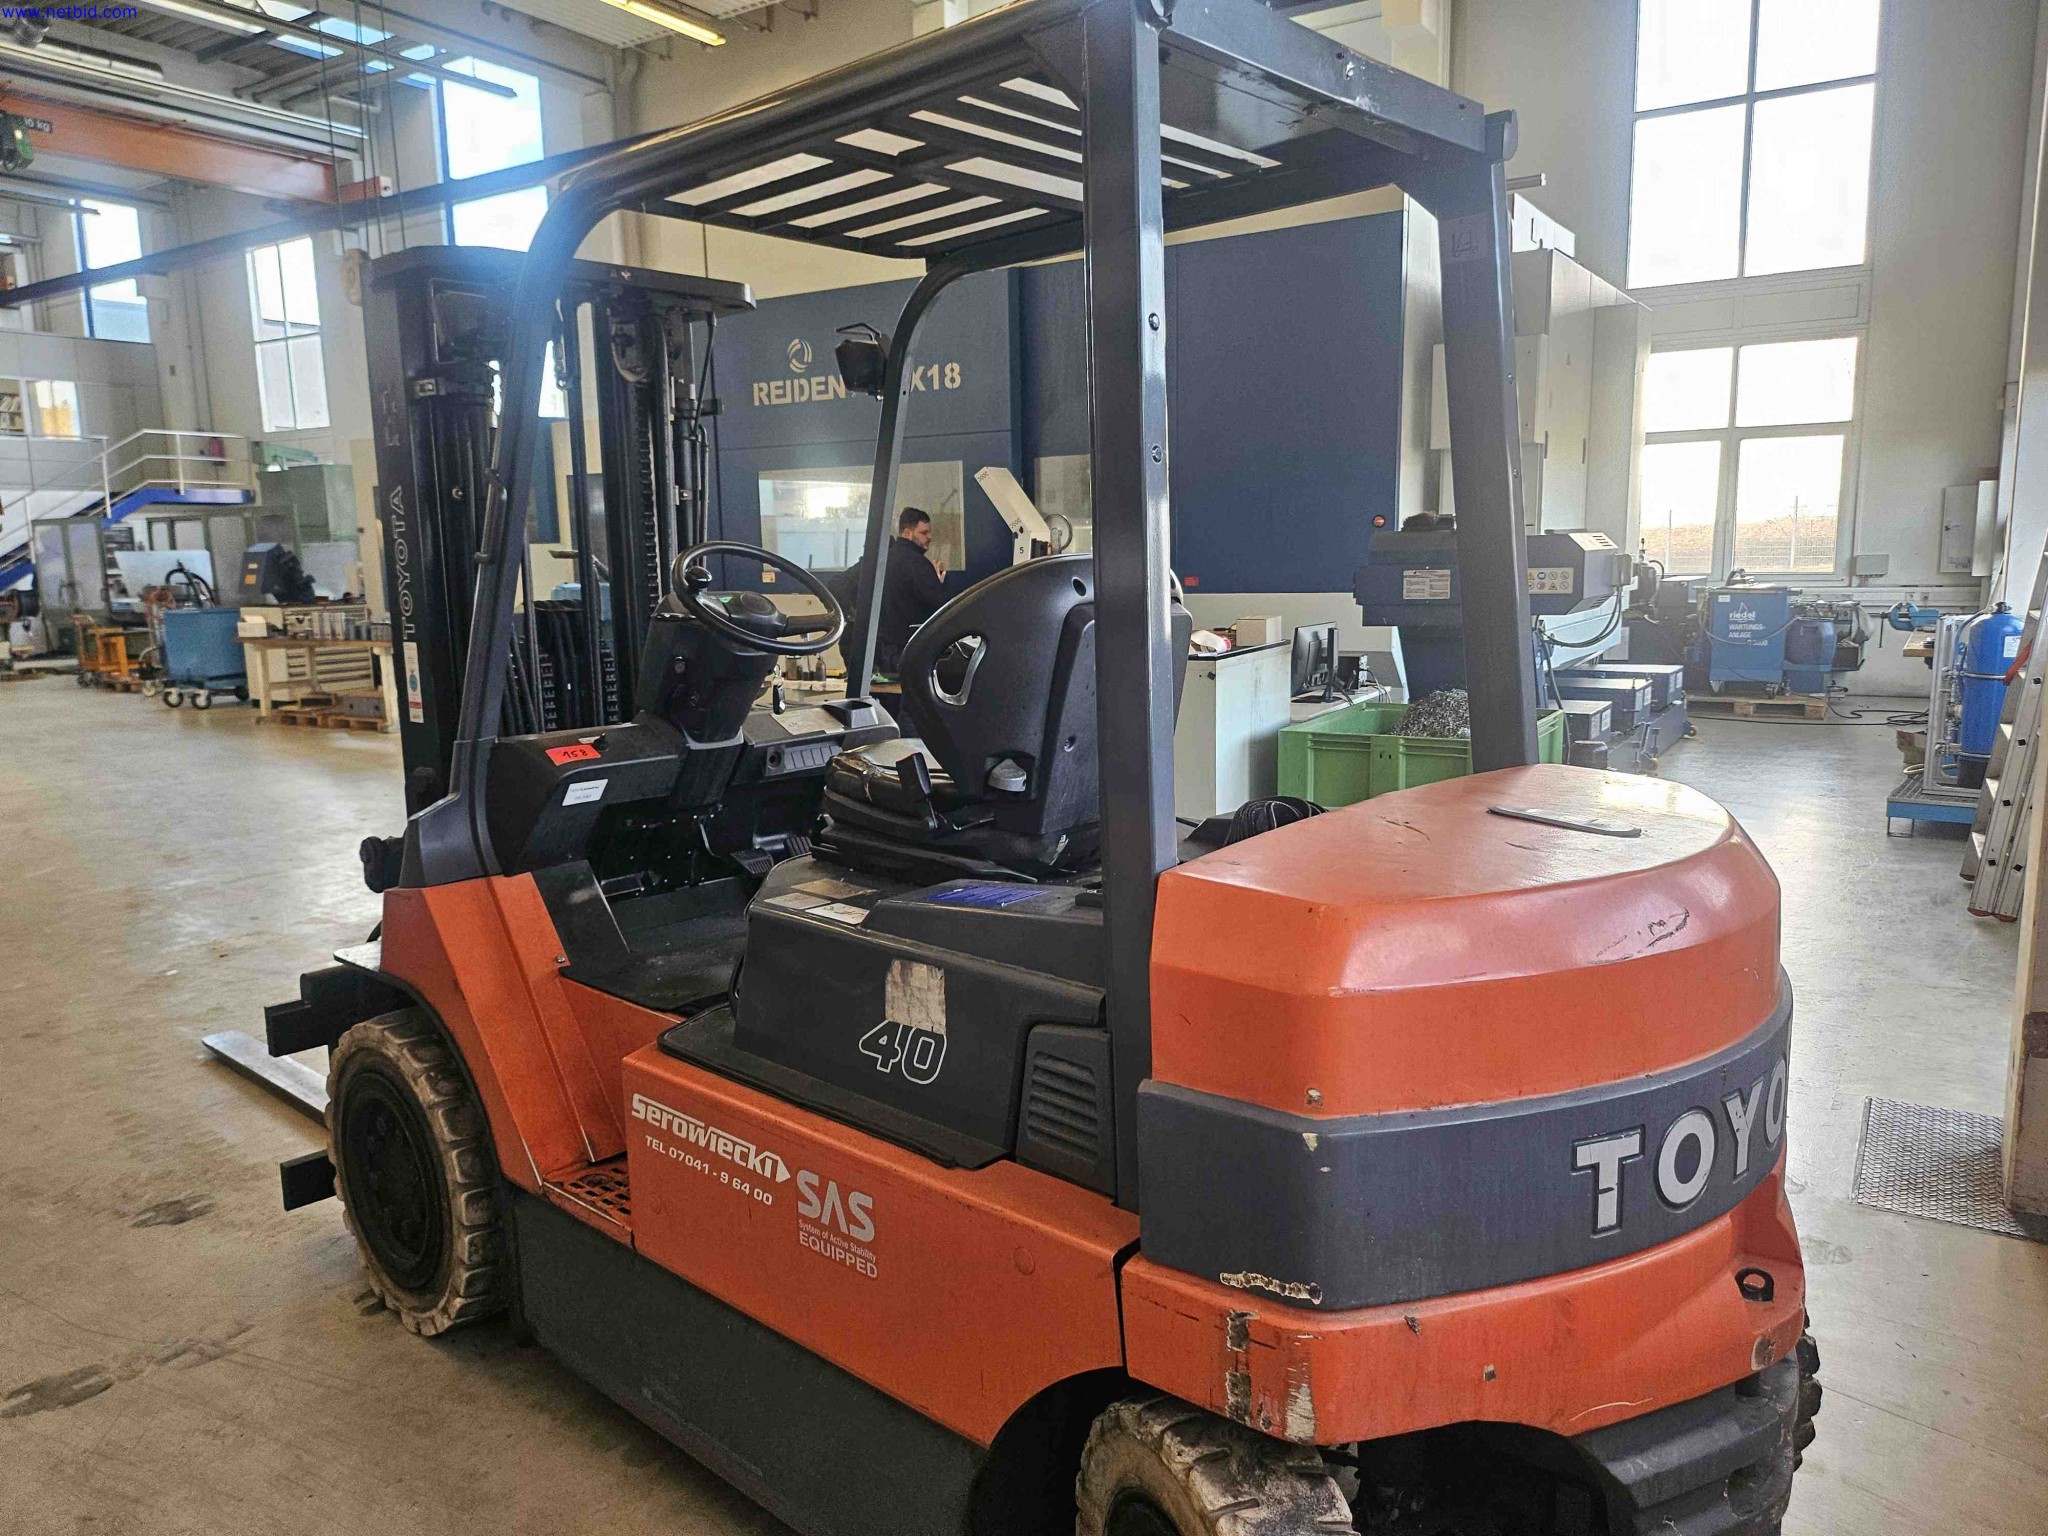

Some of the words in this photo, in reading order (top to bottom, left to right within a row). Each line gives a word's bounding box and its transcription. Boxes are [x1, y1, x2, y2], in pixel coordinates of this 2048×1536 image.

[753, 374, 846, 407] REIDEN
[390, 486, 416, 640] TOYOTA
[1729, 610, 1756, 619] riedel
[1729, 623, 1766, 631] WARTUNGS-
[858, 1019, 948, 1085] 40
[645, 1135, 666, 1154] TEL
[668, 1146, 710, 1175] 07041
[720, 1171, 729, 1184] 9
[732, 1177, 750, 1195] 64
[753, 1187, 773, 1206] 00
[1576, 1057, 1786, 1230] TOYO
[796, 1169, 875, 1243] SAS
[798, 1218, 821, 1236] System
[821, 1230, 829, 1240] of
[829, 1233, 849, 1249] Active
[849, 1241, 877, 1264] Stability
[799, 1230, 878, 1279] EQUIPPED
